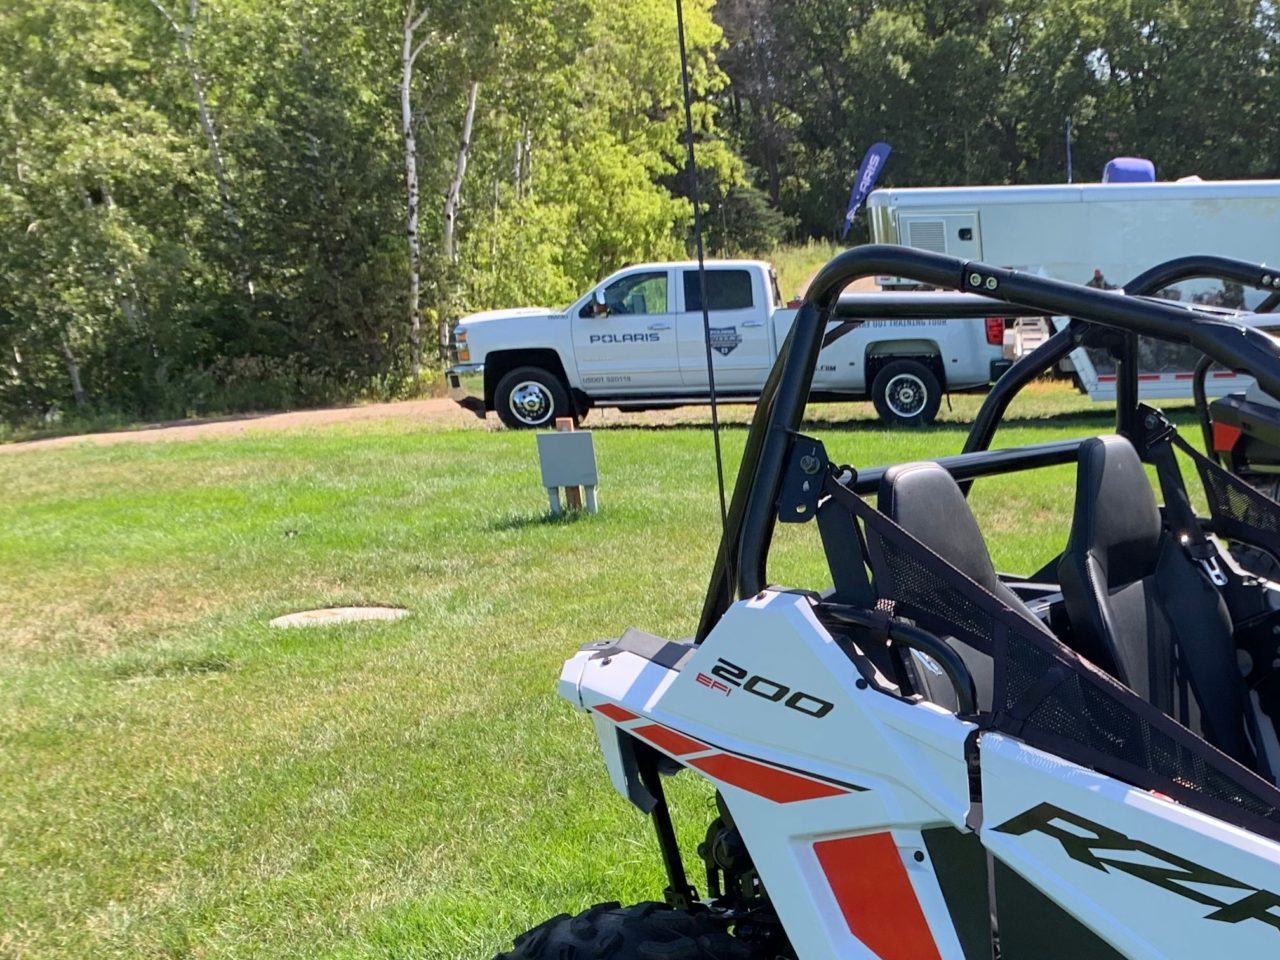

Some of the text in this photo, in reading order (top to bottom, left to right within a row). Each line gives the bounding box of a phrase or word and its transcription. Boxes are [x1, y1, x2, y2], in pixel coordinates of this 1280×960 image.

[589, 332, 661, 344] POLARIS
[695, 672, 732, 697] EFI
[711, 657, 834, 718] 200
